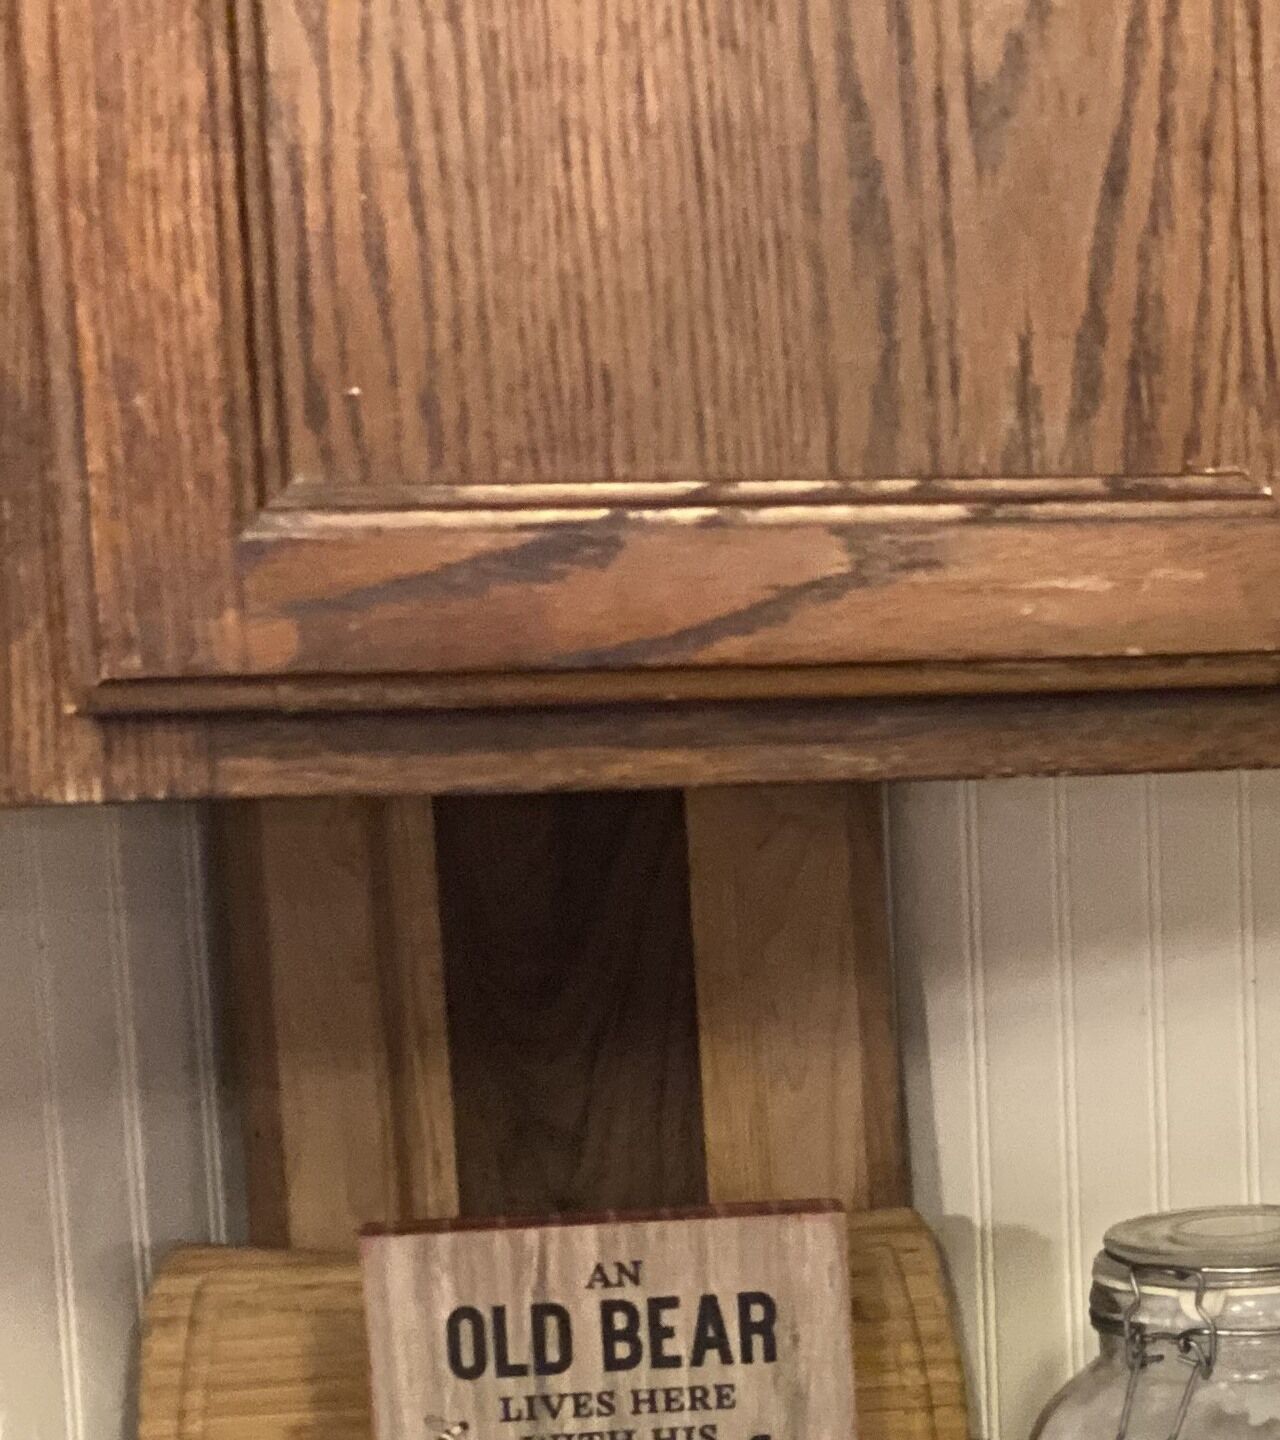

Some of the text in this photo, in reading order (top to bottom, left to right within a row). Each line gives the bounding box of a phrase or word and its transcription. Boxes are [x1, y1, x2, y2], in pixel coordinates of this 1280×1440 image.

[585, 1259, 644, 1290] AN
[446, 1291, 779, 1381] OLD BEAR
[500, 1383, 737, 1424] LIVES HERE
